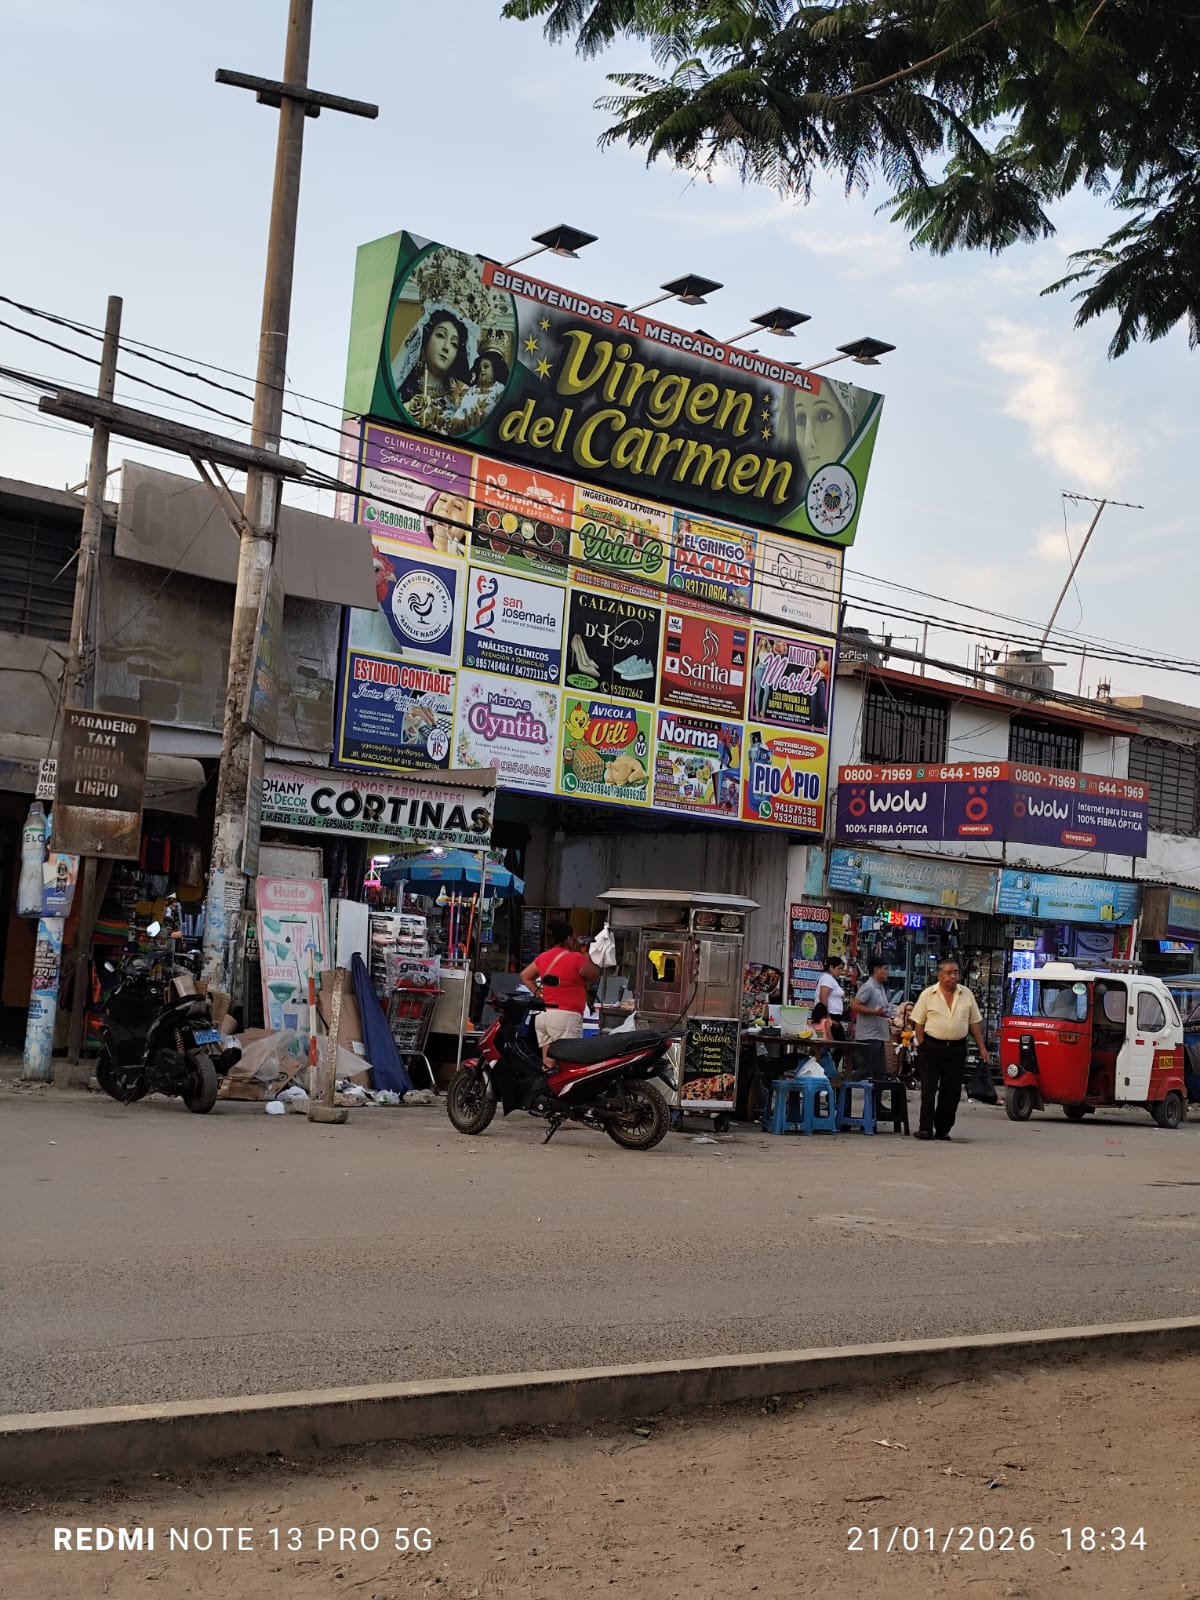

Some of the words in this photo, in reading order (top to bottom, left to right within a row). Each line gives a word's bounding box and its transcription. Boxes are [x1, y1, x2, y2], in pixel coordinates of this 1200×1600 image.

[493, 271, 613, 323] BIENVENIDOS
[618, 314, 640, 333] AL
[645, 323, 725, 361] MERCADO
[729, 351, 812, 390] MUNICIPAL
[556, 329, 752, 437] Virgen
[423, 446, 457, 463] DENTAL
[498, 398, 574, 453] del
[573, 409, 792, 505] Carmen
[582, 490, 623, 507] INGRESANDO
[630, 503, 638, 511] LA
[684, 534, 696, 549] EL
[698, 539, 744, 560] GRINGO
[675, 548, 749, 586] PACHAS
[503, 596, 523, 609] san
[578, 594, 655, 622] CALZADOS
[477, 640, 513, 655] ANÁLISIS
[514, 647, 549, 662] CLÍNICOS
[354, 658, 400, 687] ESTUDIO
[400, 667, 452, 695] CONTABLE
[761, 653, 820, 695] Maribel
[488, 692, 531, 711] MODAS
[71, 714, 137, 734] PARADERO
[470, 704, 547, 742] Cyntia
[88, 732, 117, 748] TAXI
[660, 719, 718, 749] Norma
[844, 769, 872, 781] 0800
[881, 768, 912, 781] 71969
[940, 767, 963, 779] 644
[972, 766, 1000, 778] 1969
[1015, 768, 1041, 784] 0800
[1049, 774, 1076, 789] 71969
[1098, 781, 1117, 794] 644
[1123, 785, 1144, 799] 1969
[262, 779, 304, 796] OHANY
[387, 785, 465, 804] FABRICANTES!
[794, 771, 820, 800] PIO
[274, 792, 307, 808] DECOR
[1077, 802, 1105, 814] Internet
[1106, 806, 1120, 817] para
[1121, 807, 1127, 817] tu
[1129, 810, 1143, 819] casa
[266, 811, 291, 825] MUEBLES
[297, 815, 316, 826] SILLAS
[311, 787, 489, 835] CORTINAS
[845, 824, 867, 833] 100%
[868, 824, 894, 834] FIBRA
[896, 822, 928, 834] ÓPTICA
[1077, 814, 1096, 825] 100%
[1097, 817, 1117, 829] FIBRA
[1118, 817, 1142, 831] ÓPTICA
